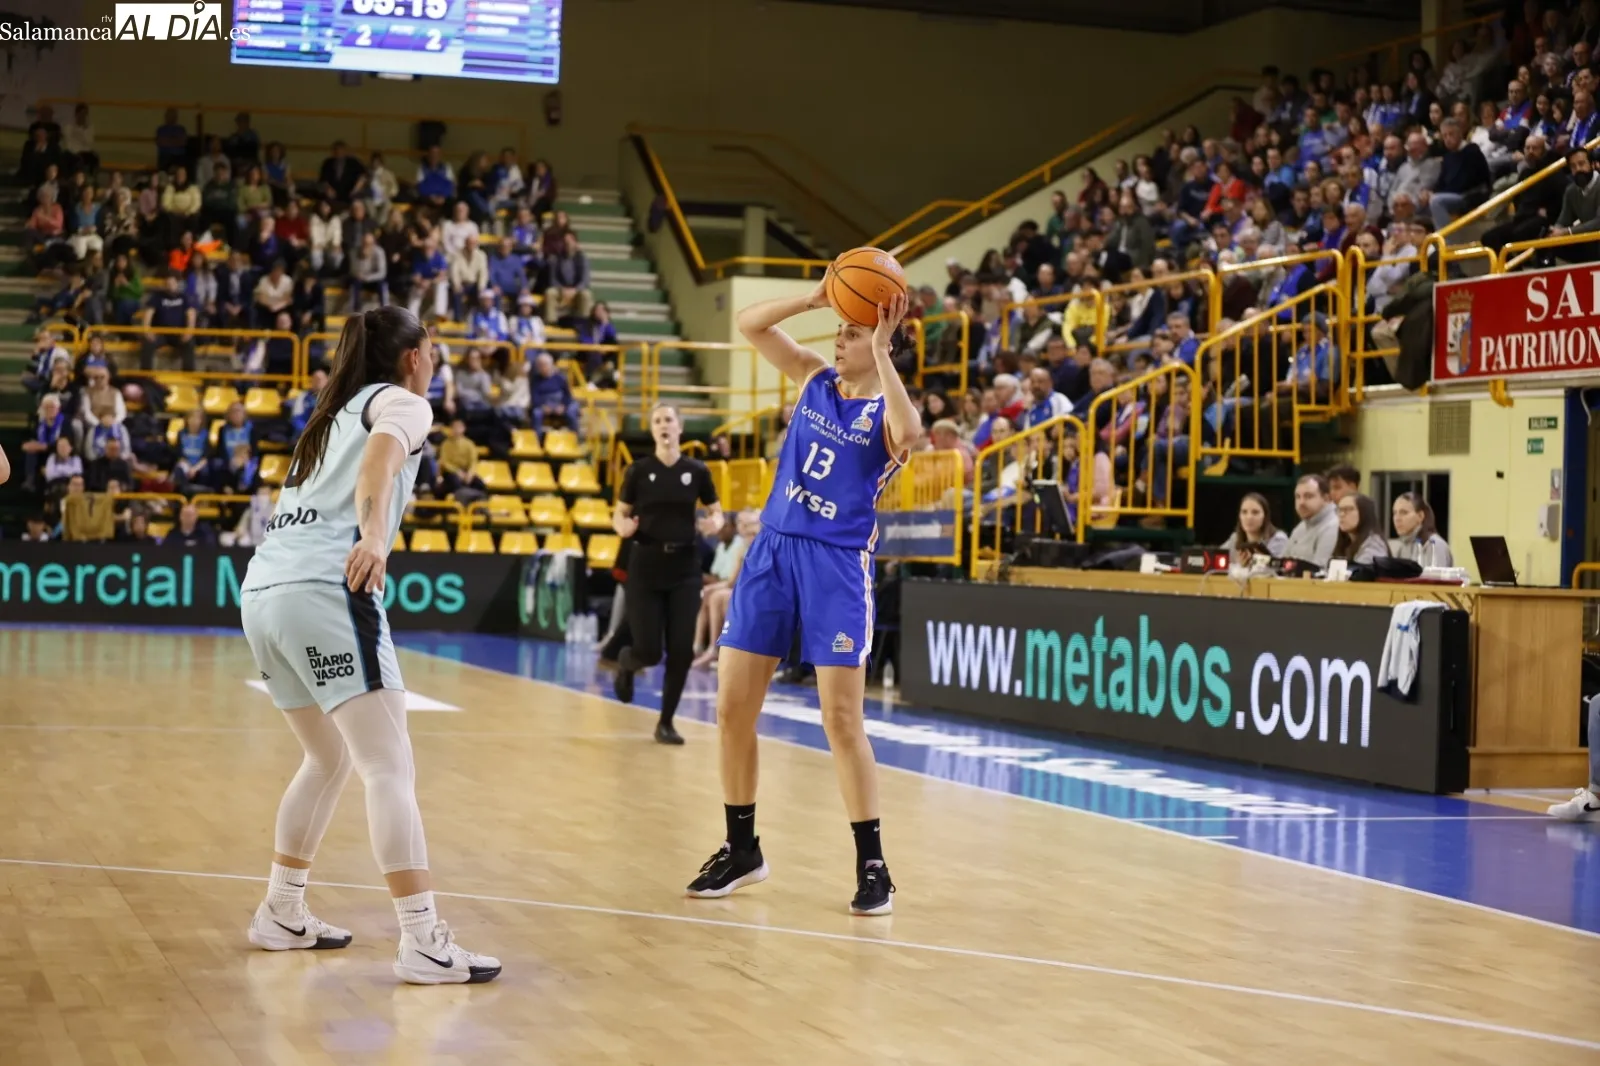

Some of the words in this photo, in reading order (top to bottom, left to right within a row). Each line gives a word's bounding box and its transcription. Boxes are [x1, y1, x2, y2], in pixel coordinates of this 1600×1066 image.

[355, 24, 372, 46] 2
[425, 28, 442, 51] 2
[843, 432, 871, 447] LEÓN
[802, 441, 836, 481] 13
[305, 645, 322, 658] EL
[309, 652, 354, 669] DIARIO
[313, 664, 355, 681] VASCO
[926, 613, 1371, 748] www.metabos.com
